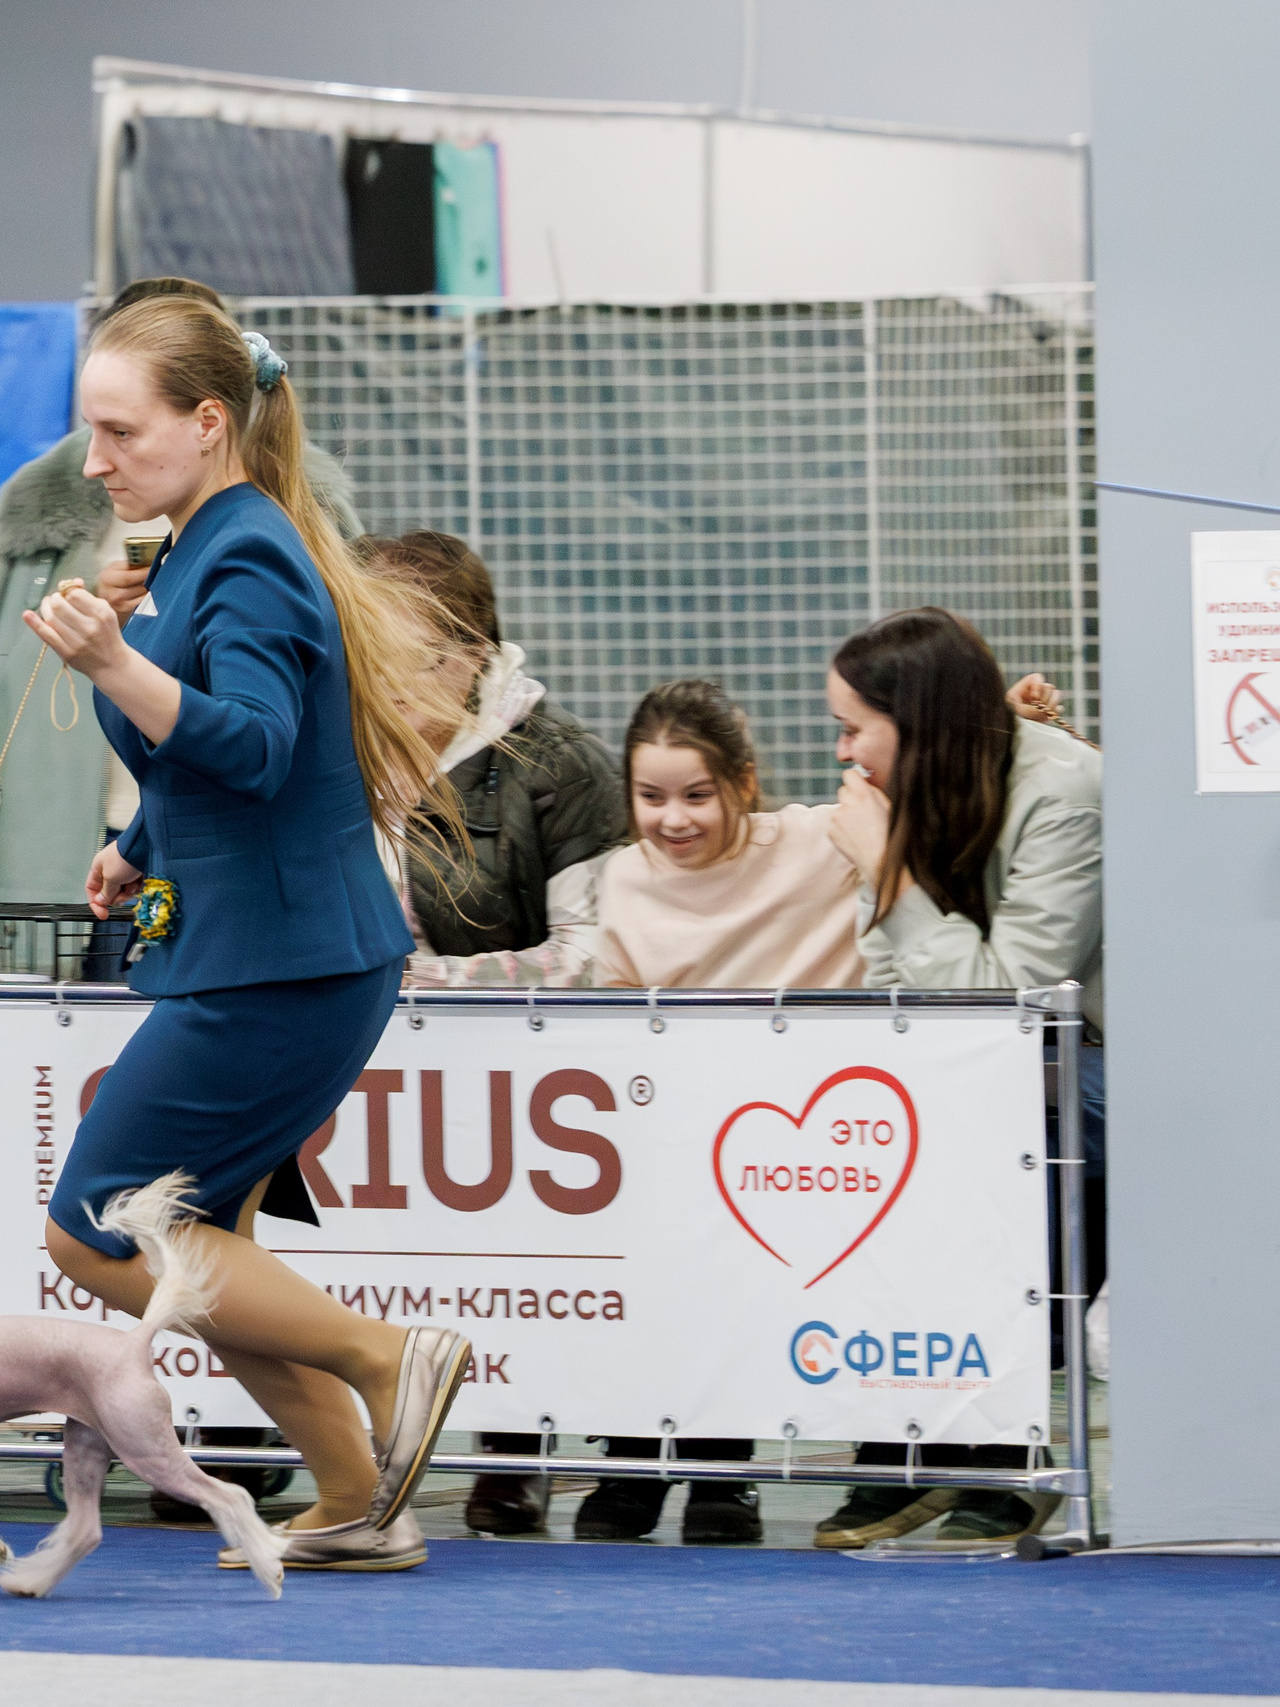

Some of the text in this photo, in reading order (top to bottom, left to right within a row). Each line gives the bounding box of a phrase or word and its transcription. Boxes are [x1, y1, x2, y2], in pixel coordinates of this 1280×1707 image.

[1207, 602, 1280, 613] ИСПОЛЬЗ
[34, 1065, 55, 1206] PREMIUM
[831, 1119, 895, 1146] ЭТО
[738, 1165, 881, 1193] ЛЮБОВЬ
[789, 1320, 992, 1385] СФЕРА
[858, 1378, 949, 1390] ВЫСТАВОЧНЫЙ
